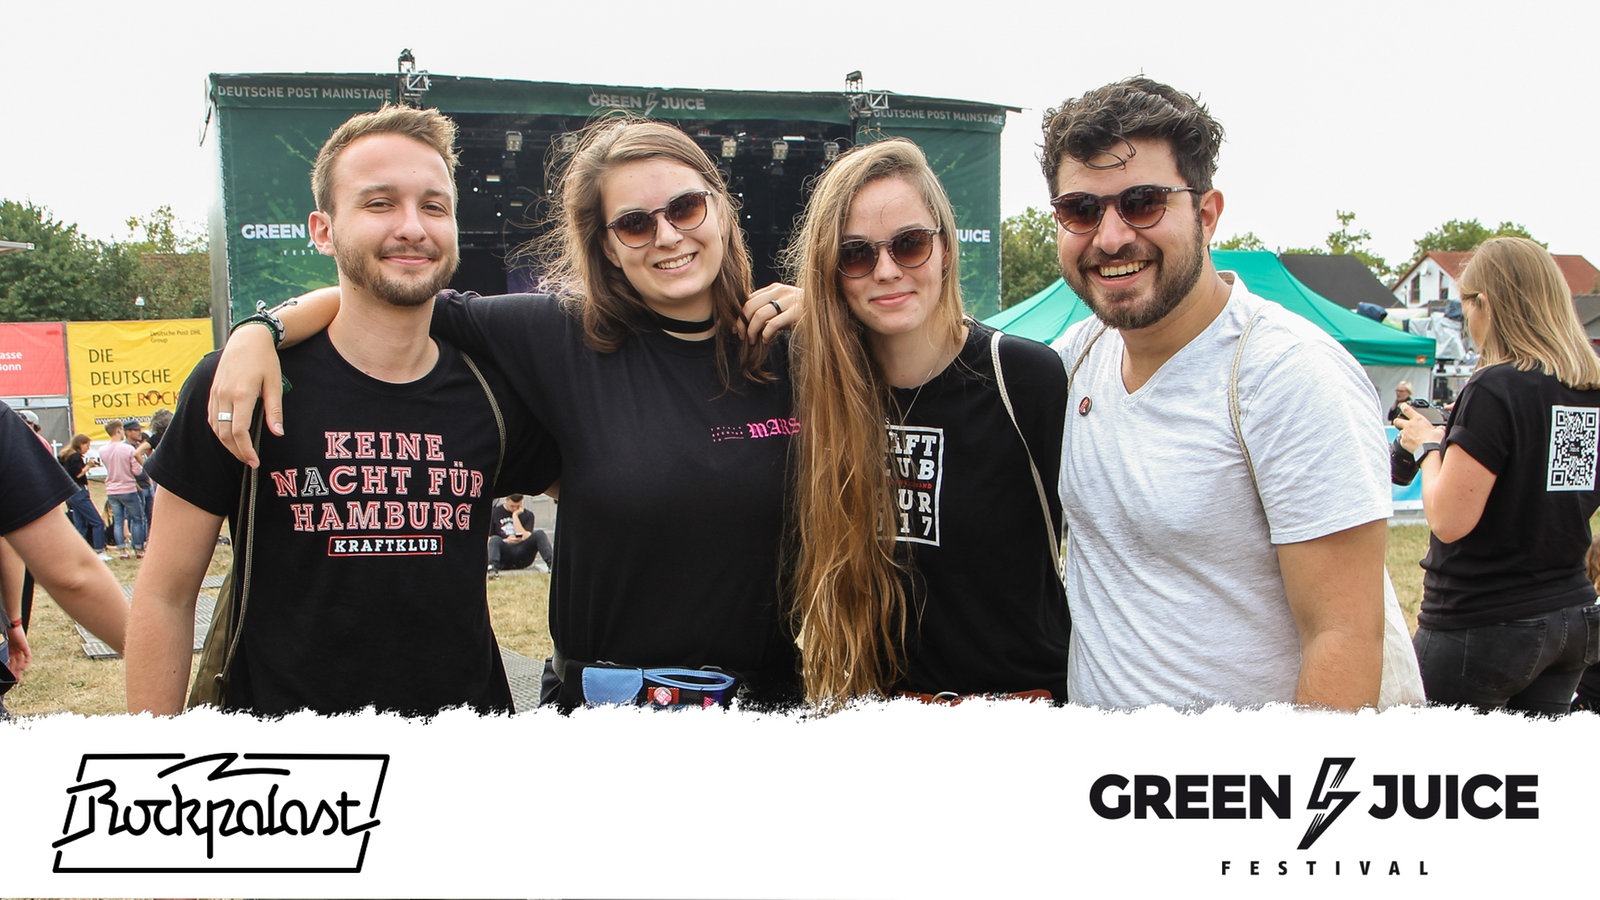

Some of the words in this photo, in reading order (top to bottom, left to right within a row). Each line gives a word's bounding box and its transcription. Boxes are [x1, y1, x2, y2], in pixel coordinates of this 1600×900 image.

[217, 85, 284, 98] DEUTSCHE
[287, 87, 319, 98] POST
[322, 88, 392, 99] MAINSTAGE
[588, 94, 642, 108] GREEN
[661, 97, 706, 110] JUICE
[927, 110, 950, 121] POST
[953, 112, 1004, 125] MAINSTAGE
[241, 223, 306, 239] GREEN
[89, 348, 114, 363] DIE
[0, 363, 22, 371] onn
[91, 368, 171, 386] DEUTSCHE
[92, 393, 131, 408] POST
[746, 417, 801, 439] MARS
[324, 431, 445, 462] KEINE
[270, 465, 412, 498] NACHT
[428, 460, 484, 498] FÜR
[290, 500, 473, 533] HAMBURG
[334, 538, 438, 553] KRAFTKLUB
